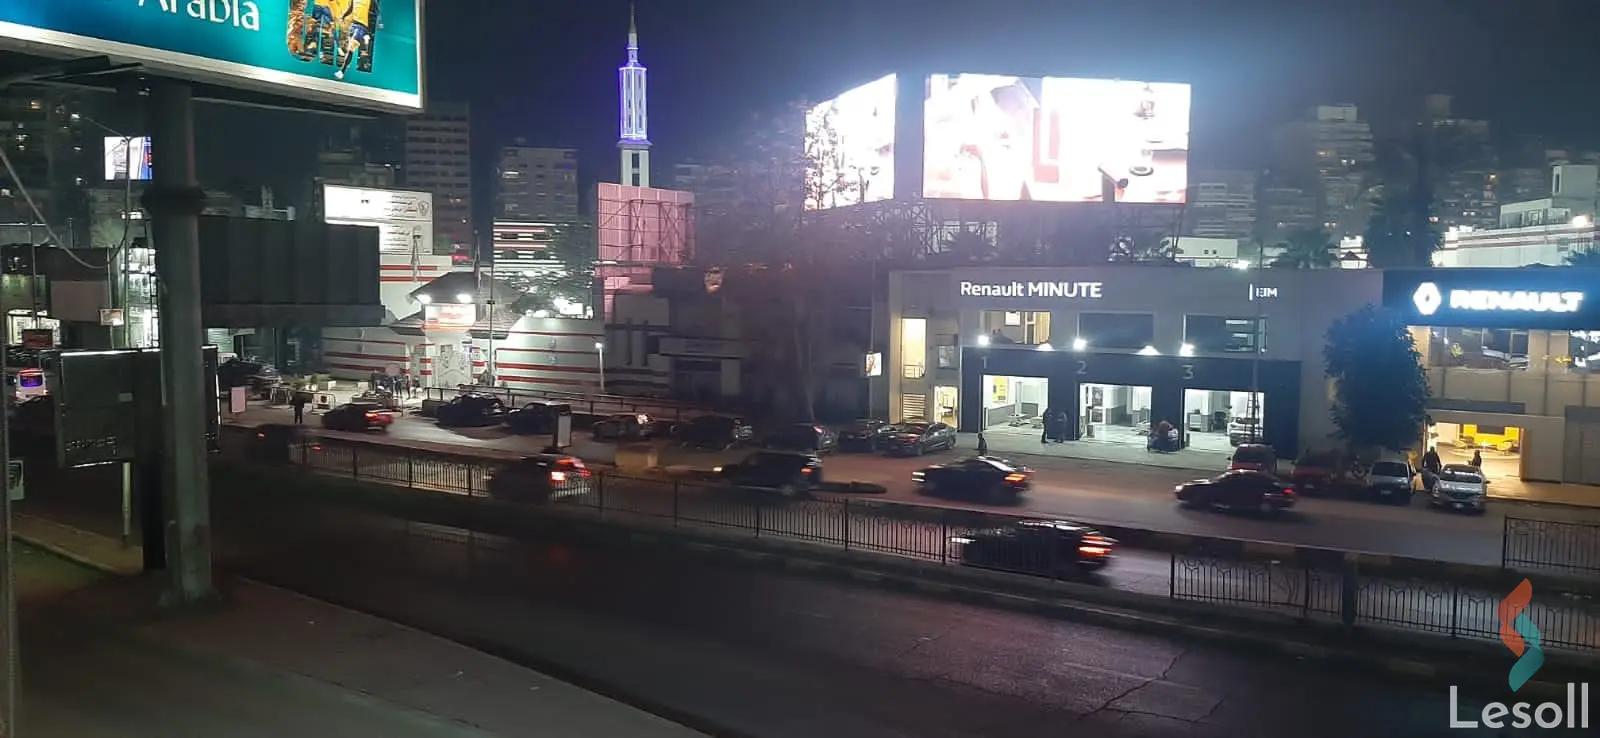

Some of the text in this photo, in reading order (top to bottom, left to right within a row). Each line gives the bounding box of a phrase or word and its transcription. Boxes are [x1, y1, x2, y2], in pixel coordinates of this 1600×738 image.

[138, 0, 260, 32] abia
[960, 281, 1103, 298] Renault MINUTE
[1449, 289, 1584, 312] RENAULT
[981, 356, 988, 369] 1
[1076, 360, 1087, 375] 2
[1181, 364, 1194, 380] 3
